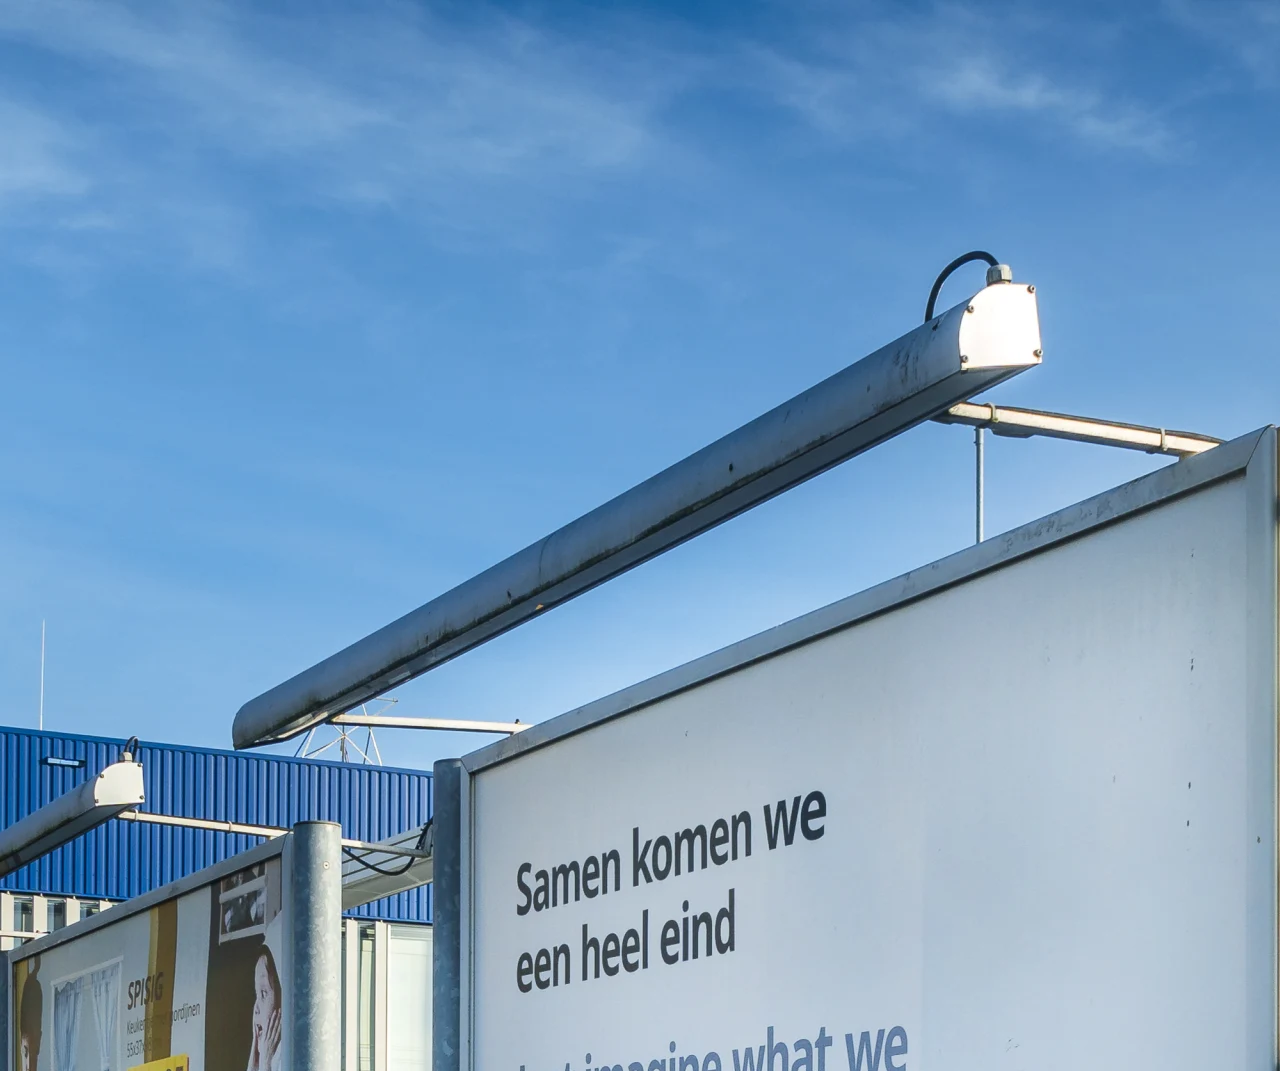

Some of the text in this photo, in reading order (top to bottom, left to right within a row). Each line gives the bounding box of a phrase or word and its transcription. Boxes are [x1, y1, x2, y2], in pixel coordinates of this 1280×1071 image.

[517, 790, 826, 916] Samen komen we
[127, 972, 164, 1010] SPISIG
[517, 888, 735, 993] een heel eind
